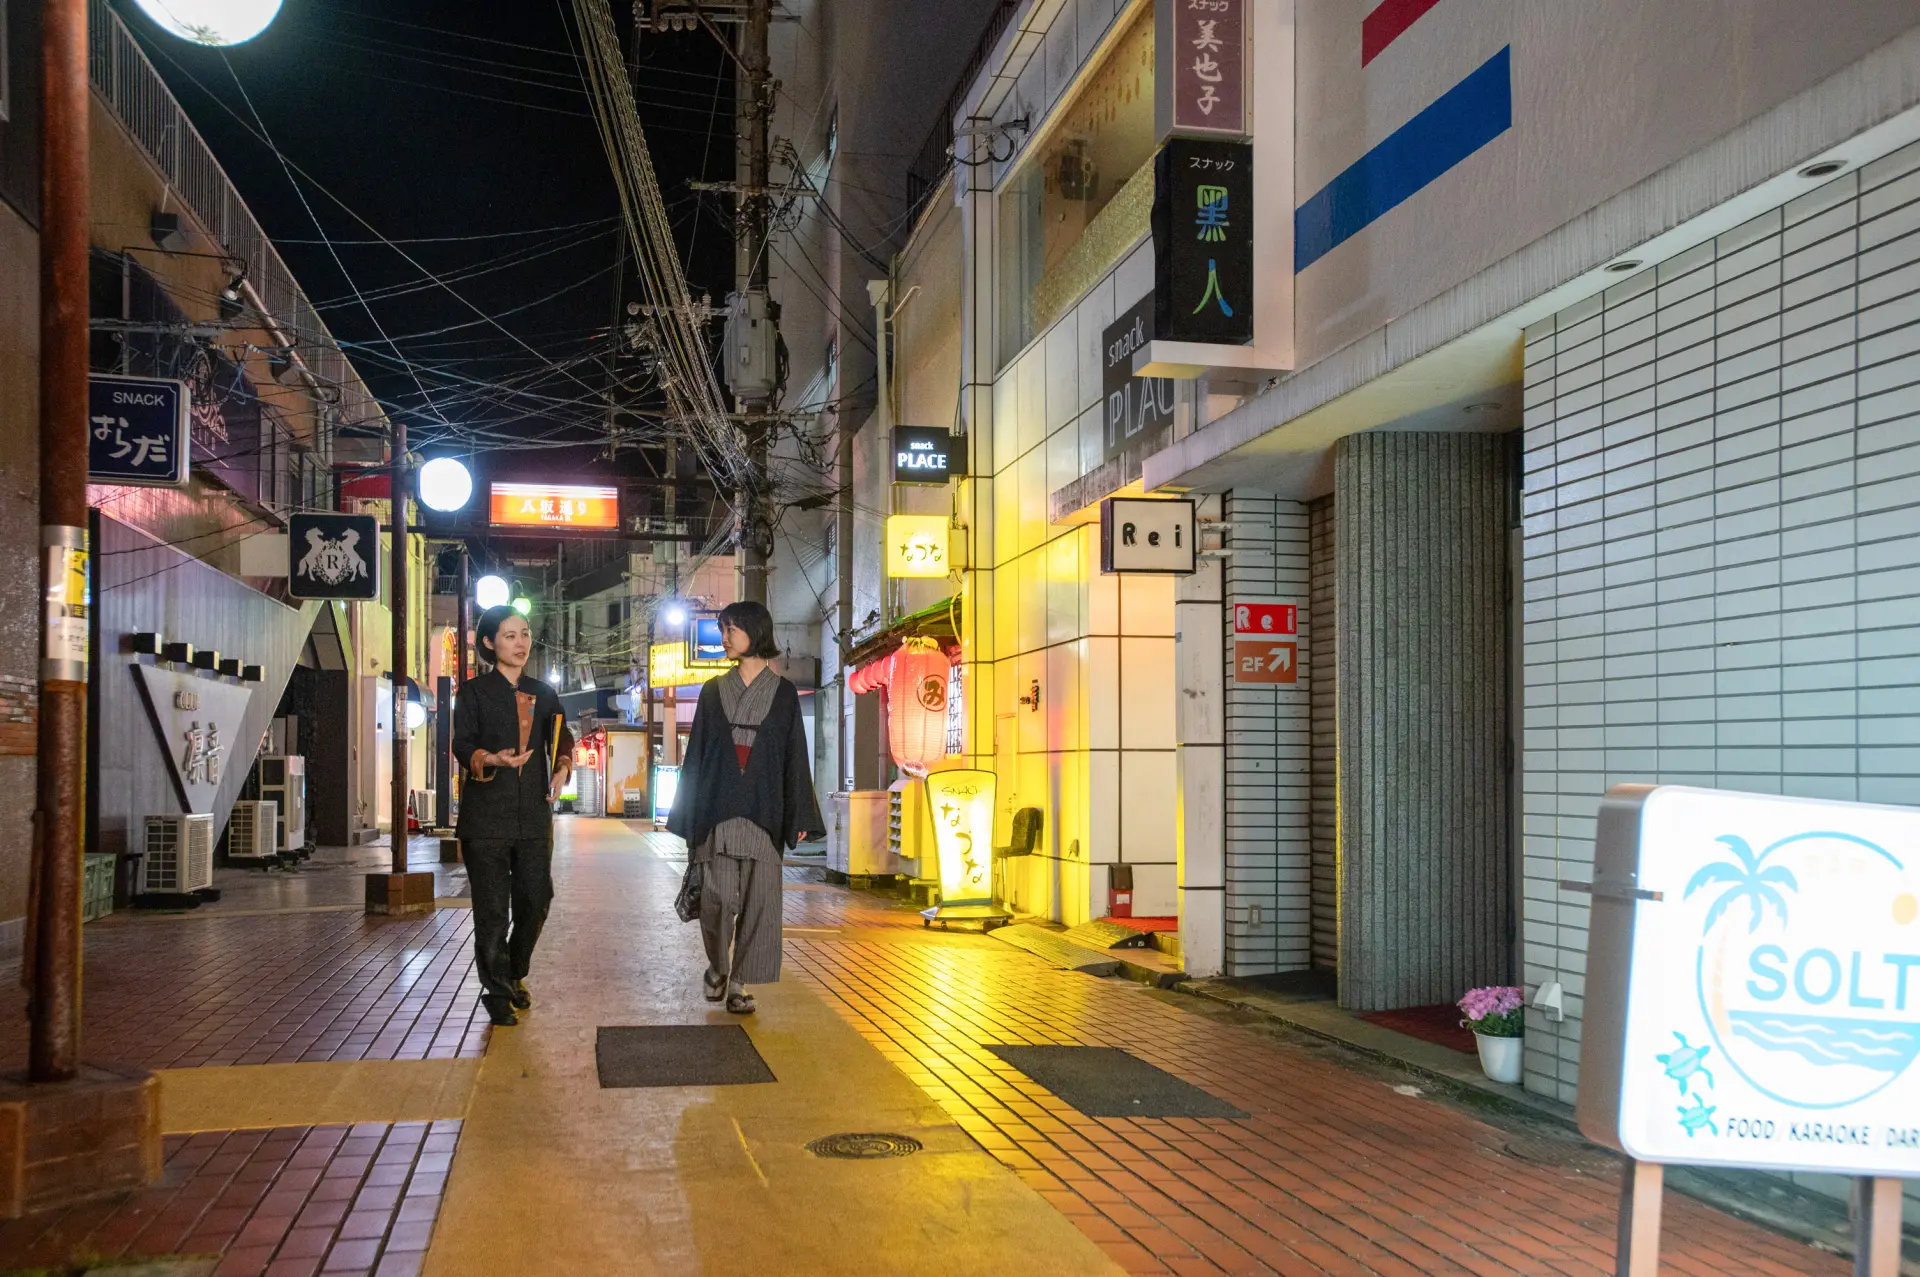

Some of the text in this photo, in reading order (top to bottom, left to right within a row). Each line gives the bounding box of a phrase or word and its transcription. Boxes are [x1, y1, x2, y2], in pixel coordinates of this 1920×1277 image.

[1188, 0, 1229, 12] スナック
[1187, 20, 1224, 115] 美也子
[1189, 157, 1235, 171] スナック
[1109, 315, 1144, 368] snack
[113, 391, 165, 407] SNACK
[910, 441, 934, 450] snack
[897, 452, 947, 469] PLACE
[519, 499, 588, 516] 八坂通り
[1122, 522, 1183, 548] Rei
[326, 554, 340, 570] R
[1235, 605, 1295, 632] Rei
[1241, 656, 1265, 673] 2F
[1746, 943, 1920, 1012] SOLT
[1727, 1117, 1775, 1140] FOOD
[1789, 1122, 1870, 1147] KARAOKE
